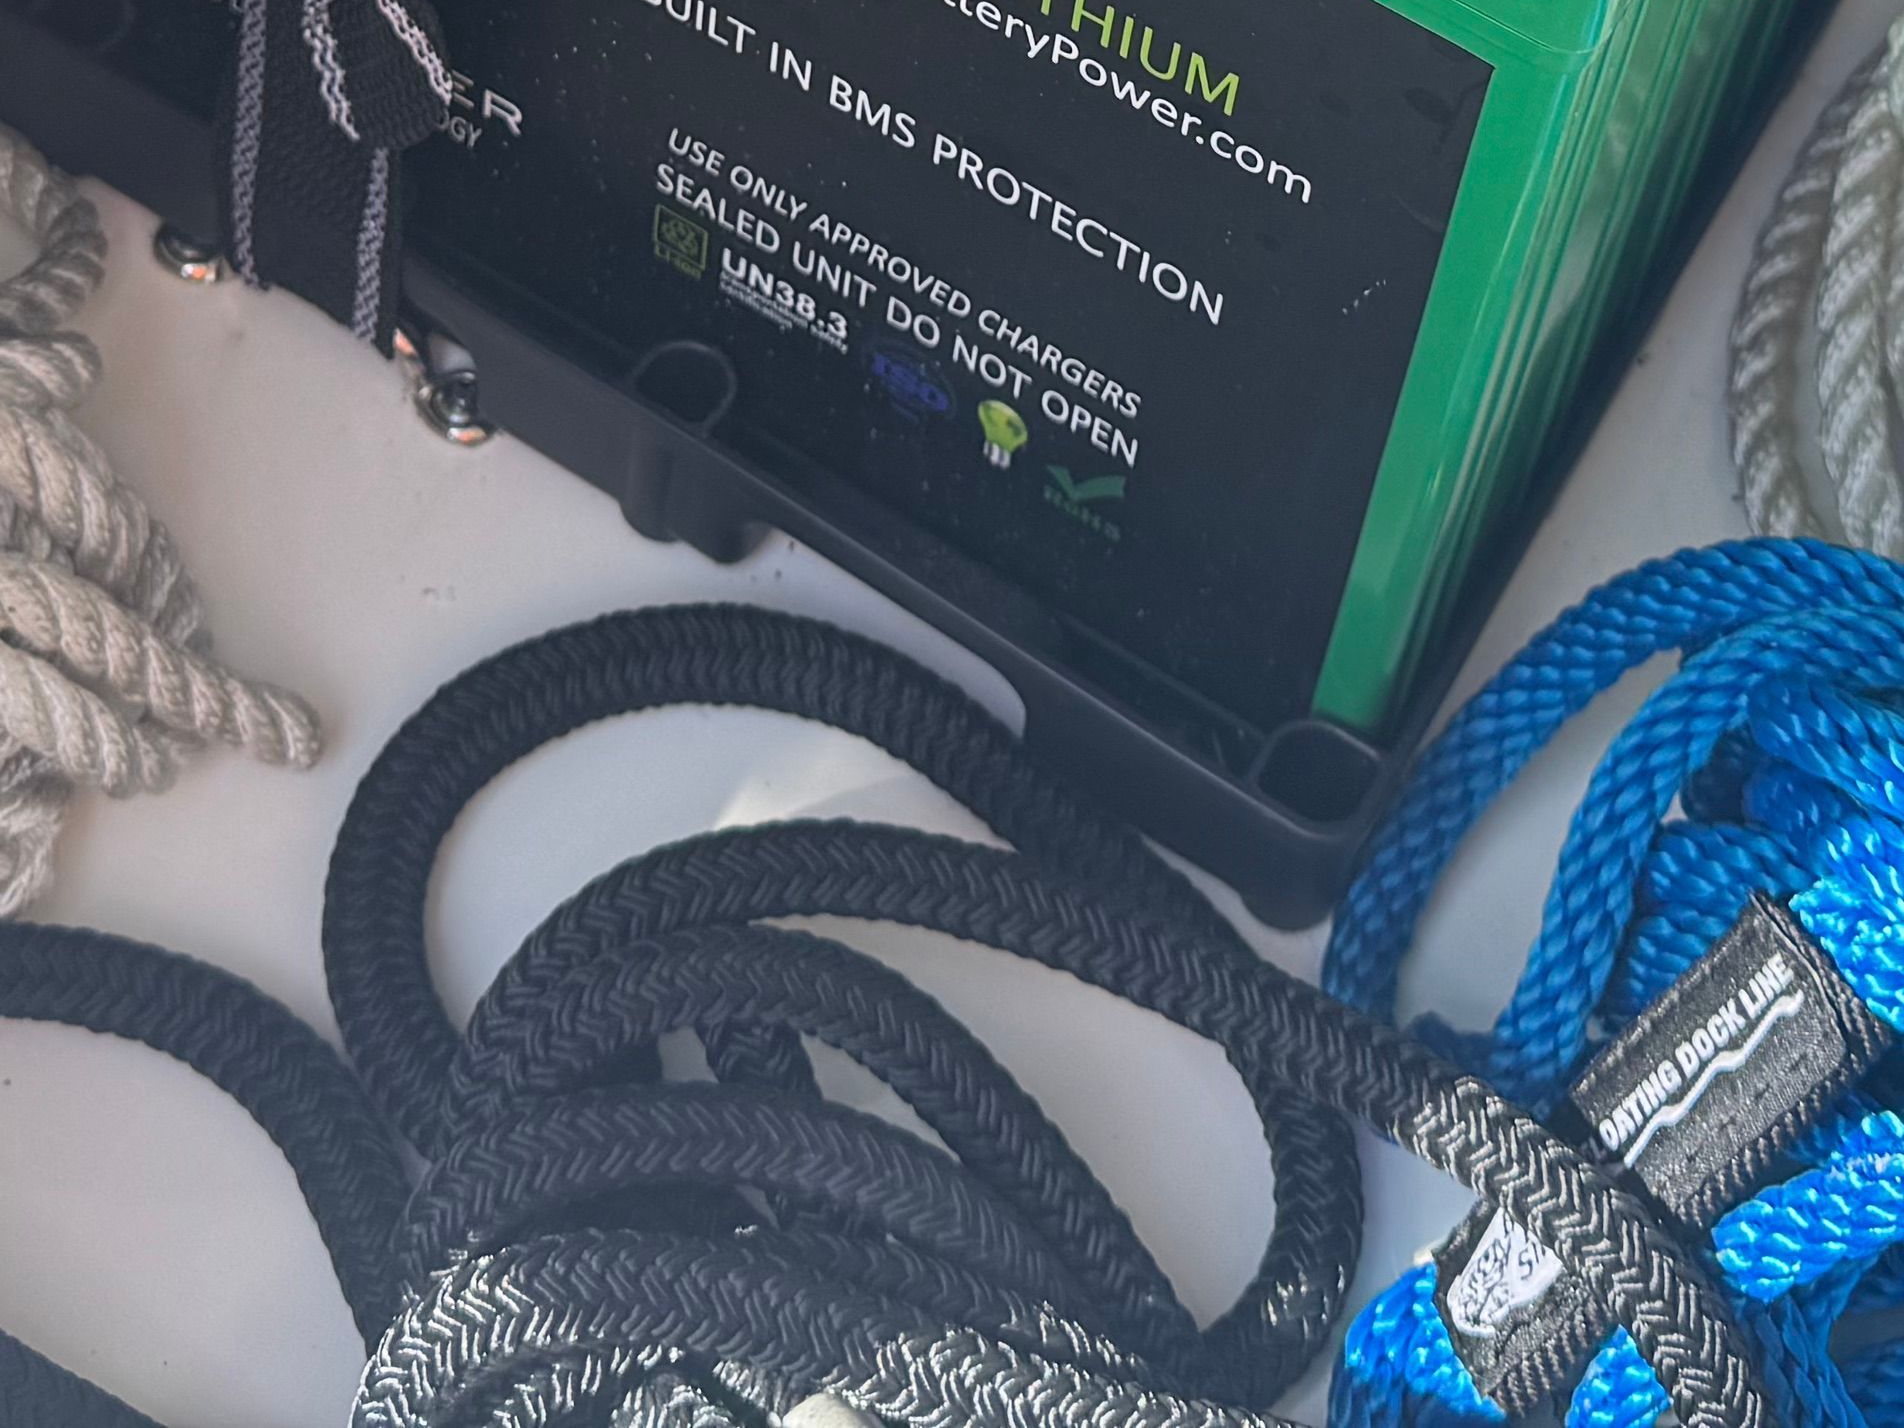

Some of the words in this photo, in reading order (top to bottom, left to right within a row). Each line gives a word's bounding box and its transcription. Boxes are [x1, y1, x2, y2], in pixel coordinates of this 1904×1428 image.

[656, 162, 781, 254] SEALED
[793, 240, 878, 308] UNIT
[885, 295, 942, 349] DO
[953, 333, 1032, 400] NOT
[1040, 389, 1139, 469] OPEN
[667, 127, 725, 178] USE
[729, 165, 808, 223] ONLY
[809, 212, 973, 318] APPROVED
[977, 308, 1142, 420] CHARGERS
[721, 247, 848, 339] UN38.3
[767, 41, 814, 93] IN
[828, 74, 917, 150] BMS
[932, 132, 1225, 326] PROTECTION
[1675, 997, 1746, 1079] DOCK
[1738, 952, 1795, 1020] LINE
